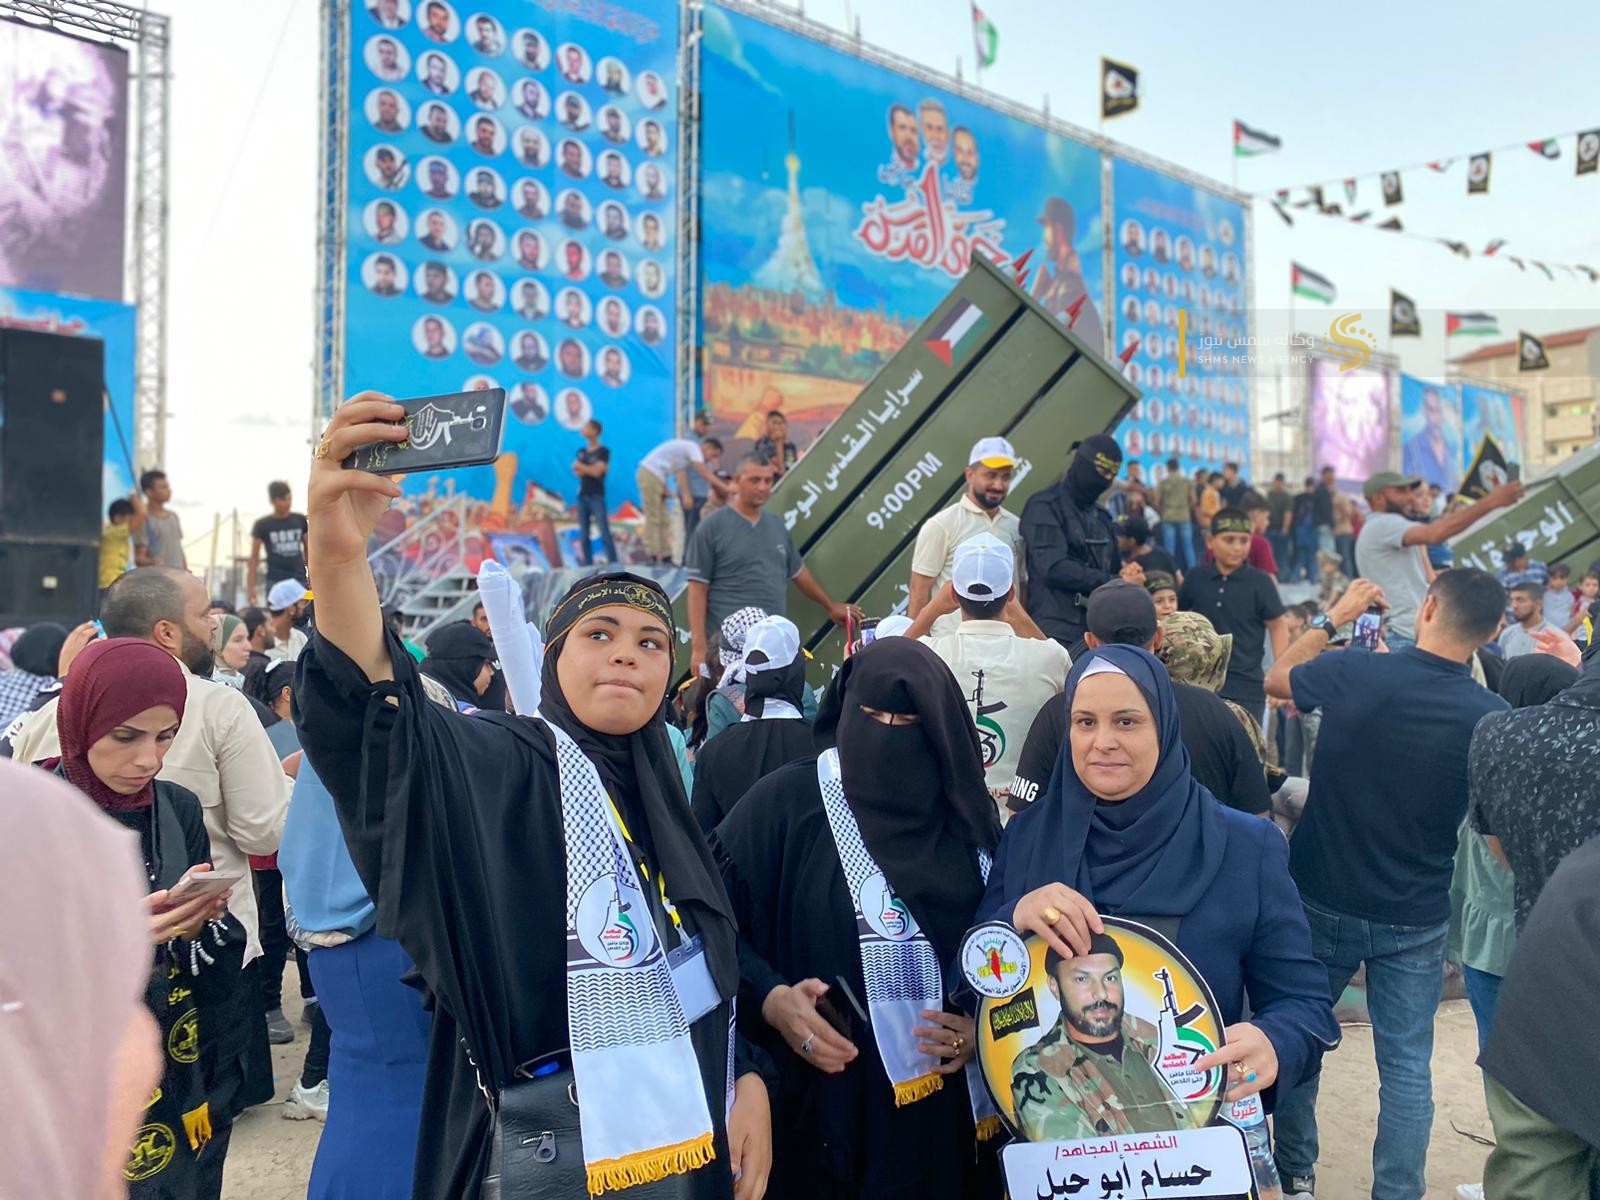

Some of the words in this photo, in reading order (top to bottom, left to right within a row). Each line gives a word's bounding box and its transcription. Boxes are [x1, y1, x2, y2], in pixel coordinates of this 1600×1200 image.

[868, 369, 924, 425] سرايا
[823, 418, 877, 492] القدس
[784, 480, 822, 531] الوح
[866, 451, 944, 531] 9:00PM
[1123, 1134, 1178, 1156] الشهيد
[1100, 1154, 1131, 1200] أبو
[1140, 1159, 1212, 1198] حسام
